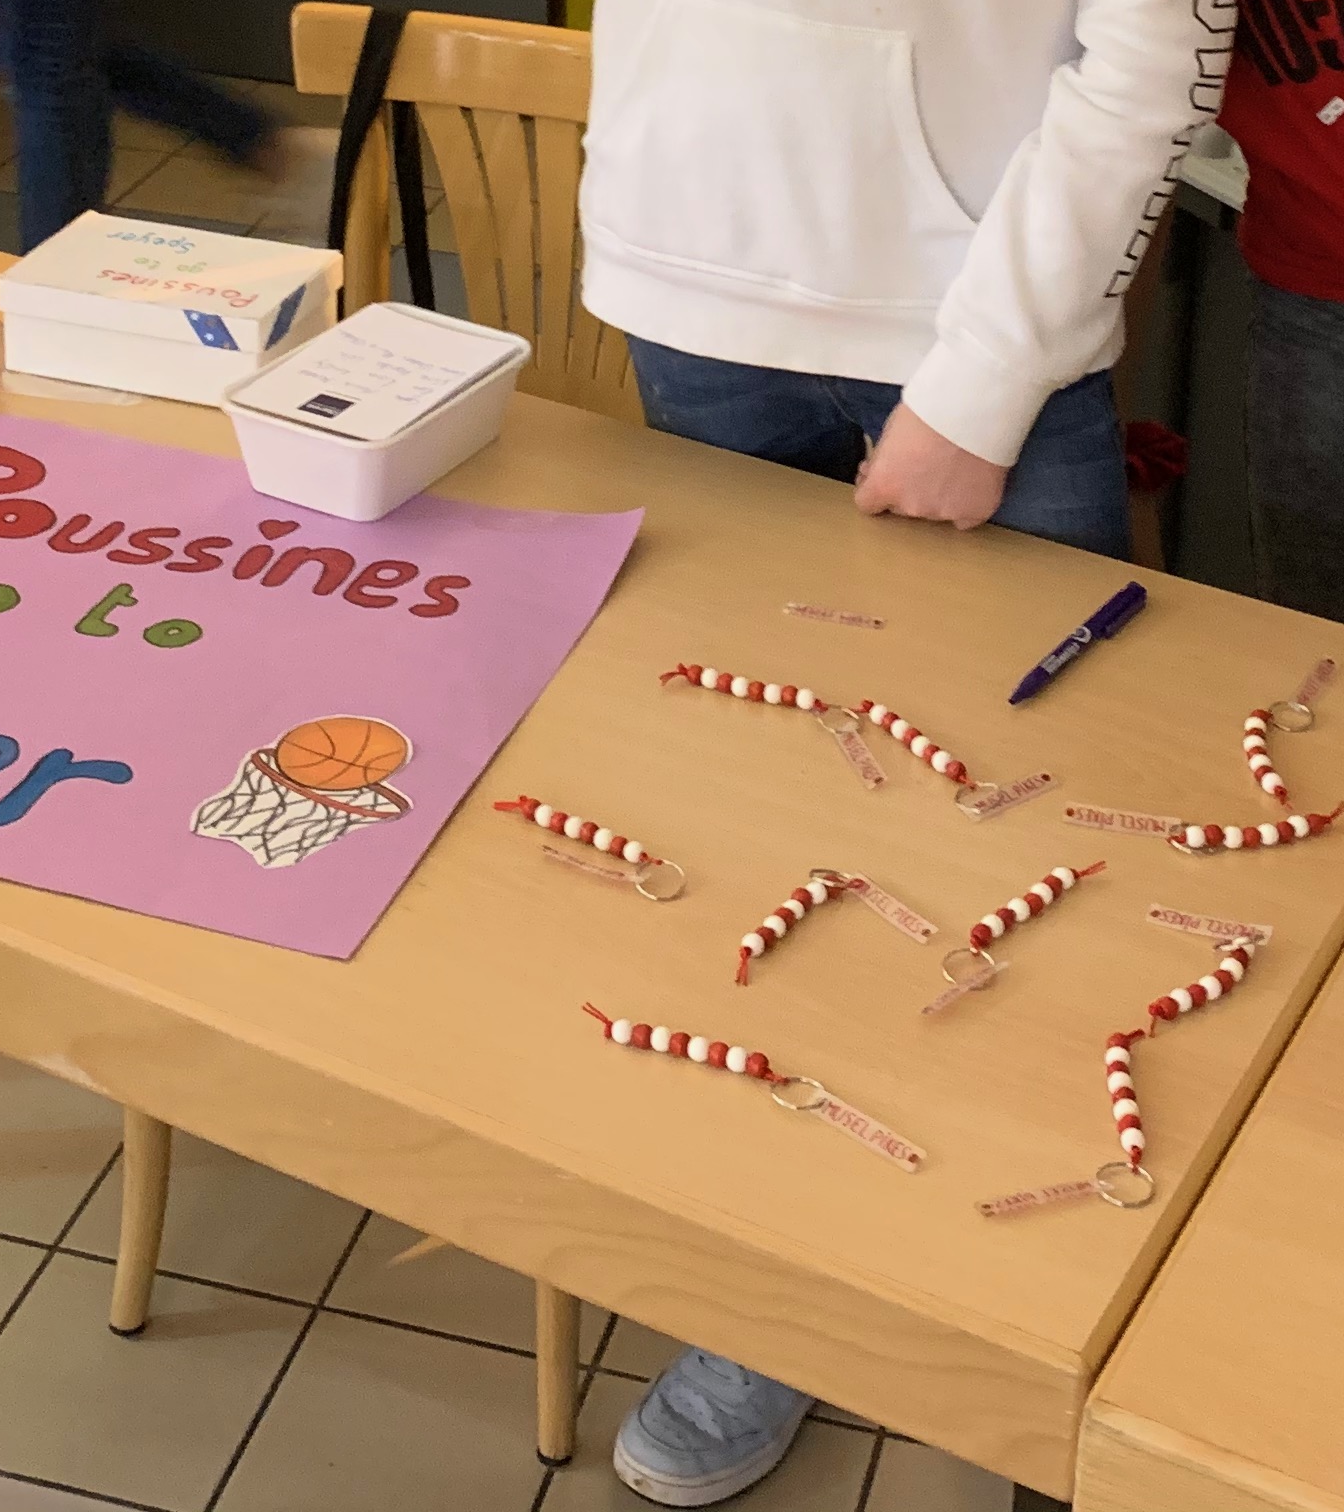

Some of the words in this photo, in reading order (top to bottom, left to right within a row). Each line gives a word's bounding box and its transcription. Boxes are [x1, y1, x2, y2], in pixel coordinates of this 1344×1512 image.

[106, 230, 196, 255] Speyer
[133, 256, 161, 271] to
[176, 261, 207, 274] go
[96, 269, 259, 308] Poussines
[74, 583, 204, 649] to
